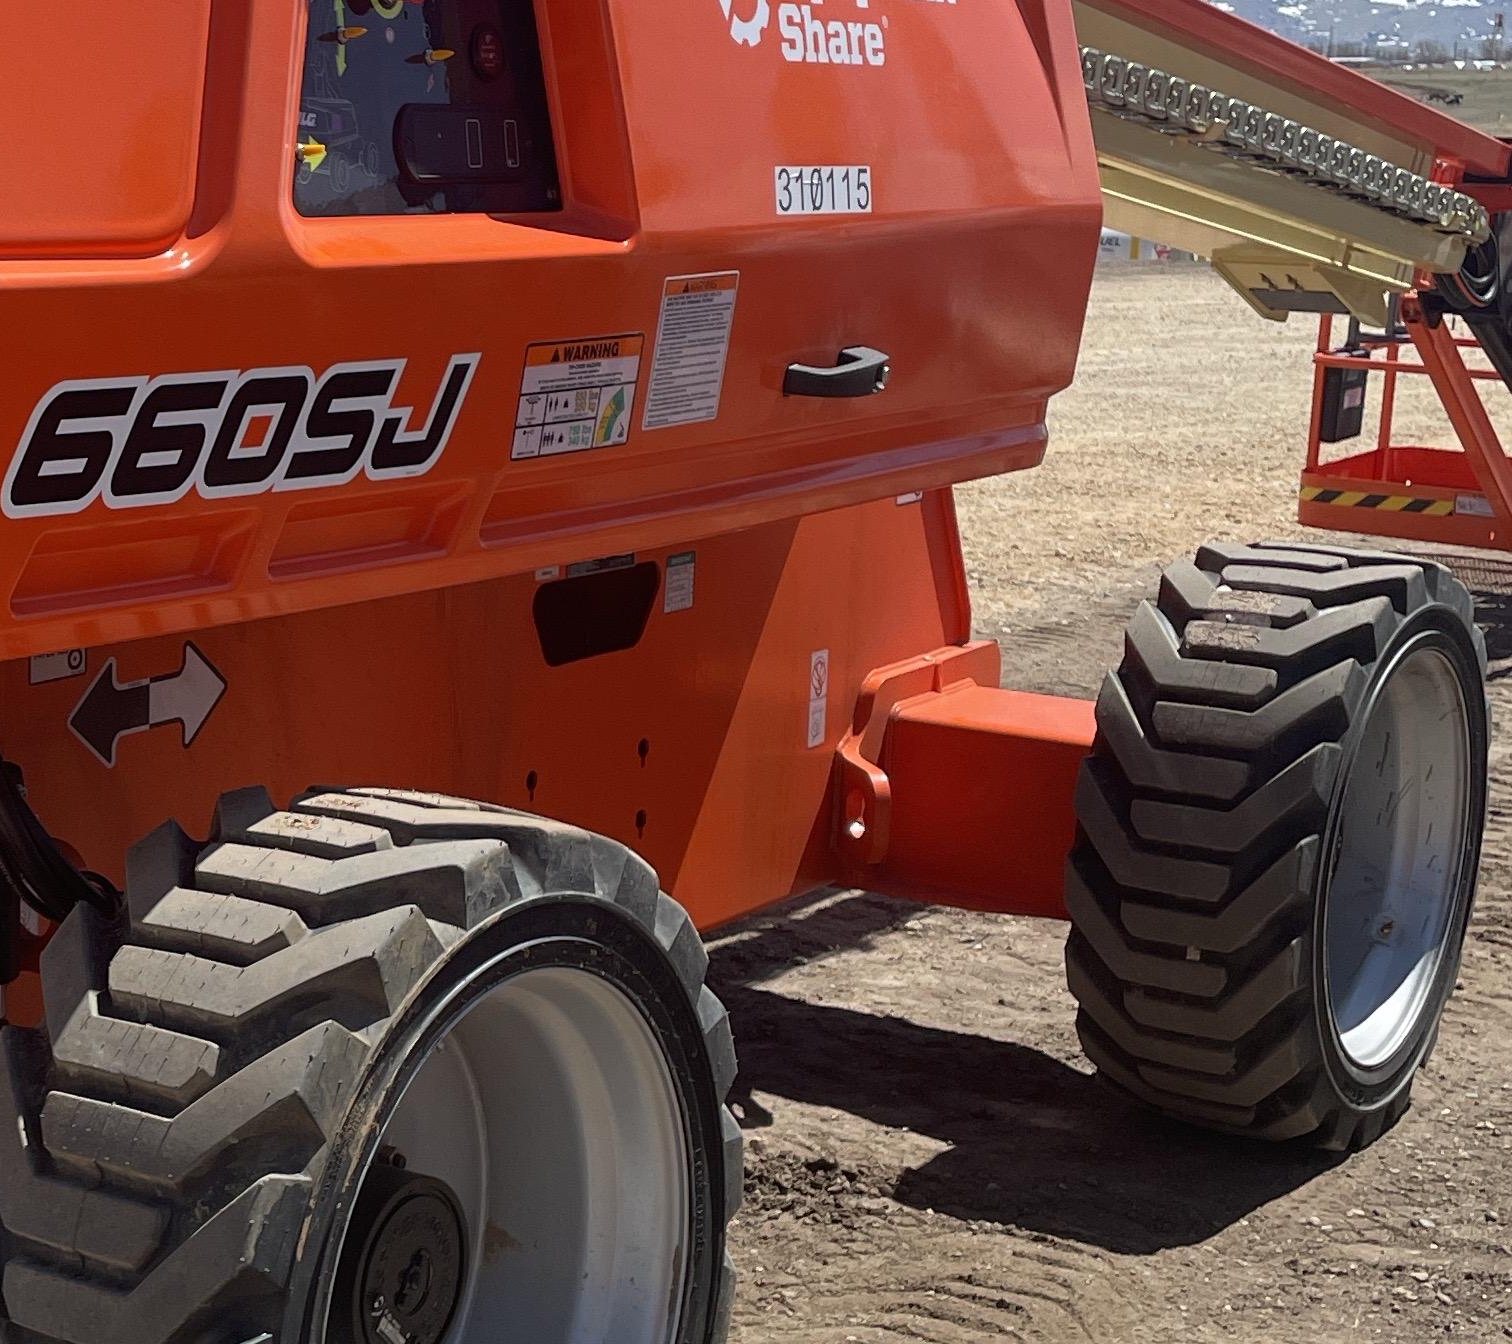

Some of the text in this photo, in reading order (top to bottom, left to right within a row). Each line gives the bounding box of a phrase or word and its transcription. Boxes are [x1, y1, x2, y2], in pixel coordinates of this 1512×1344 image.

[778, 3, 886, 66] Share
[777, 167, 871, 211] 310115
[563, 341, 620, 362] WARNING
[1, 353, 481, 519] 660SJ
